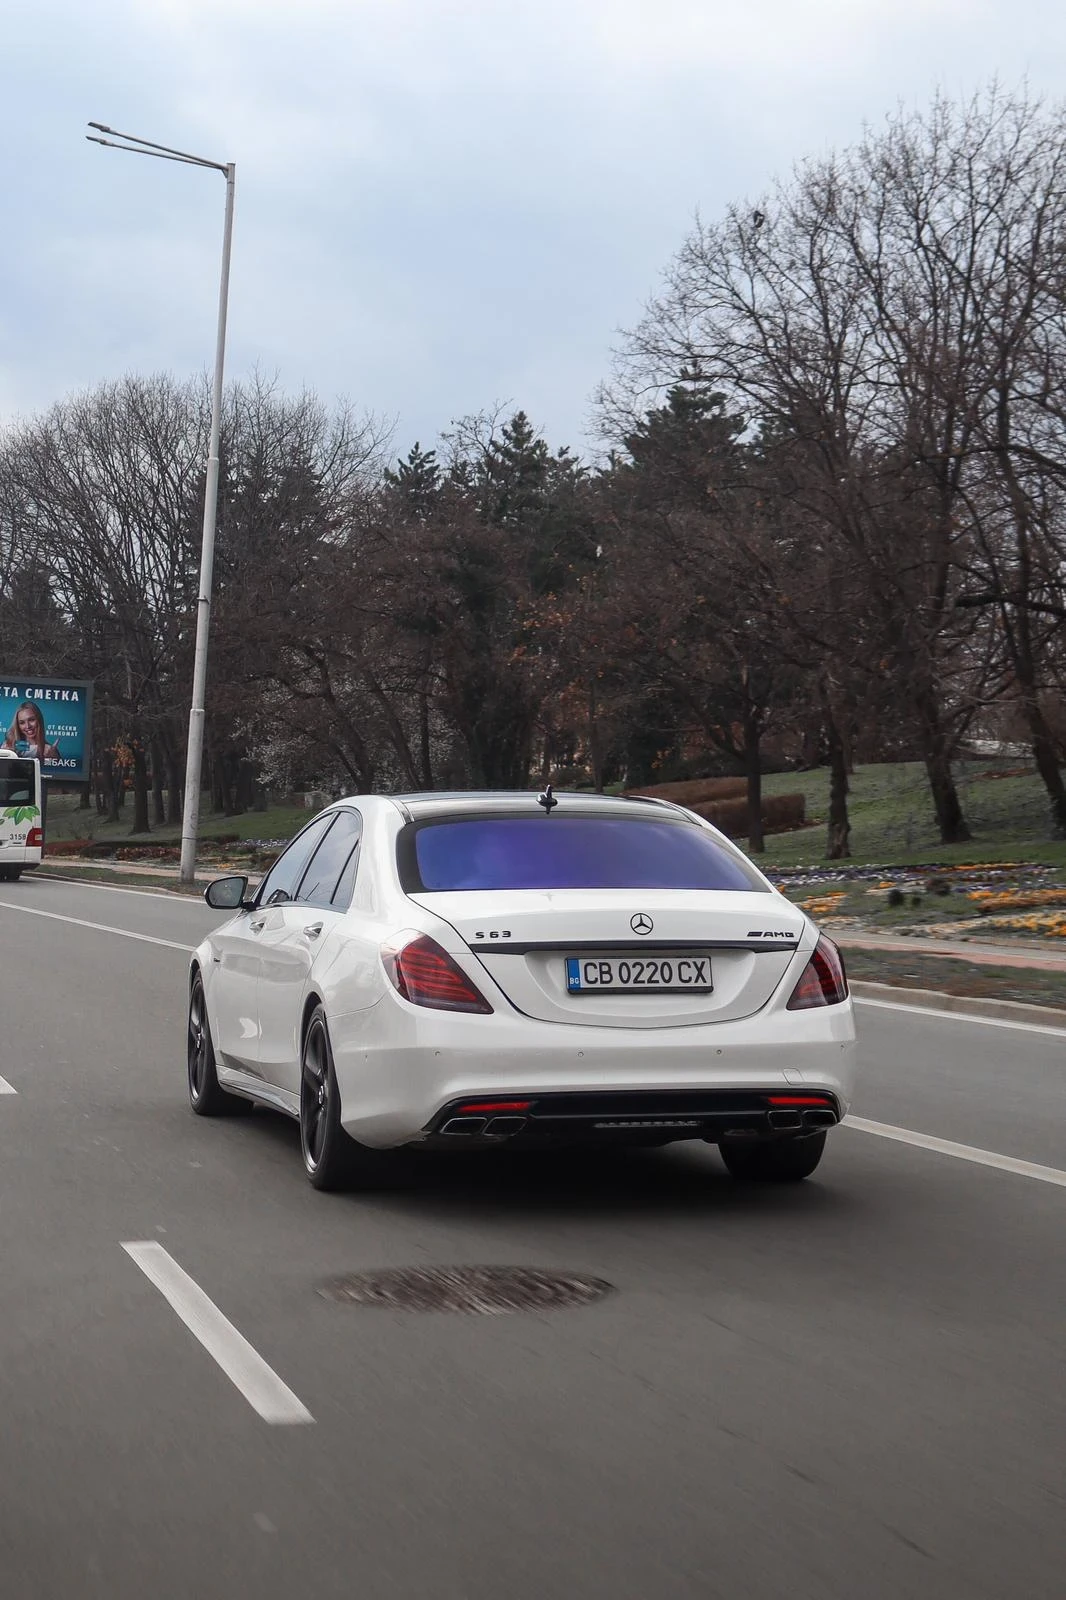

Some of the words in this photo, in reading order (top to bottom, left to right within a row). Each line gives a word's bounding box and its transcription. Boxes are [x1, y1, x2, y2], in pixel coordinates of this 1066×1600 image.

[0, 686, 18, 698] ТА
[25, 688, 79, 701] СМЕТКА
[52, 758, 76, 768] БАКБ
[10, 833, 27, 841] 3158
[475, 931, 485, 939] S
[489, 930, 512, 938] 63
[583, 961, 614, 985] CB
[618, 961, 673, 984] 0220
[677, 960, 707, 984] CX
[569, 977, 580, 985] BG
